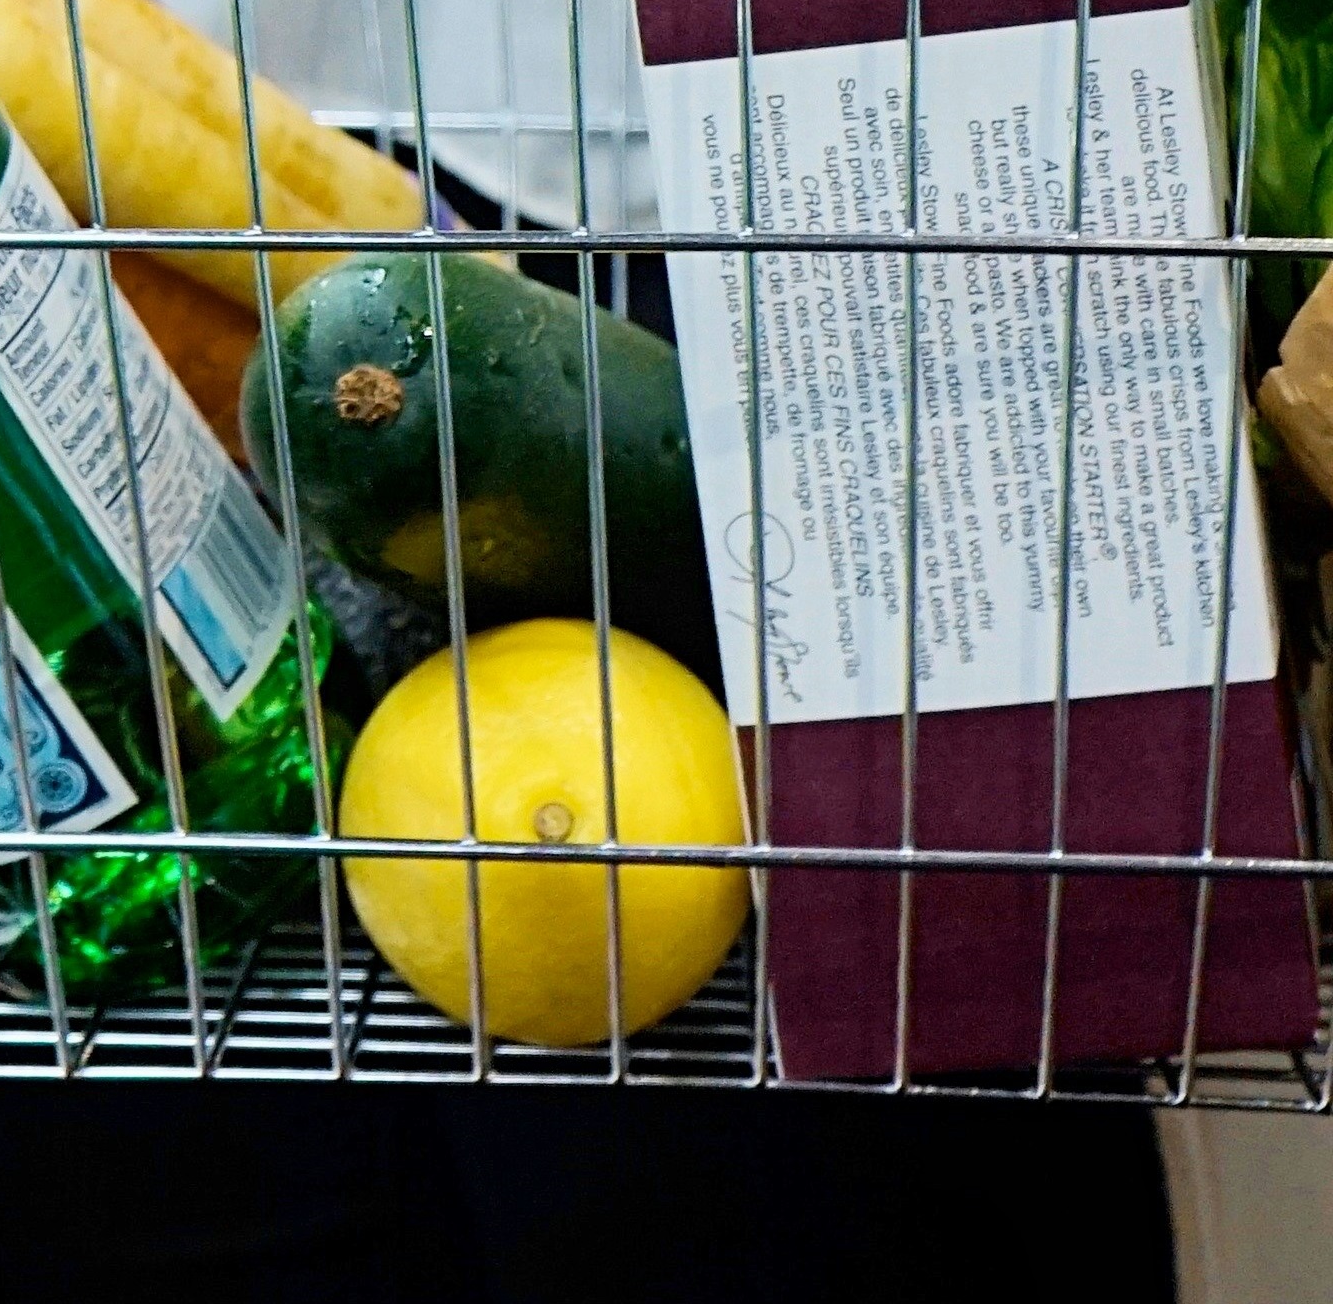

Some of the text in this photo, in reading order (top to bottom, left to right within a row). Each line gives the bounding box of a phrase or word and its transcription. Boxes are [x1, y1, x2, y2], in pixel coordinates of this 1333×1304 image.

[837, 78, 859, 121] Seul
[1130, 68, 1153, 154] delicious
[1155, 86, 1173, 106] At
[702, 114, 720, 159] vous
[766, 94, 790, 181] Délicieux
[844, 127, 859, 151] un
[864, 106, 882, 152] avec
[991, 119, 1009, 149] but
[1011, 105, 1031, 158] these
[1091, 128, 1109, 142] &
[1159, 113, 1180, 177] Lesley
[968, 120, 989, 190] cheese
[1042, 157, 1060, 172] A
[1094, 149, 1112, 181] her
[709, 165, 724, 189] ne
[843, 157, 872, 223] produit
[871, 158, 890, 203] soin,
[995, 155, 1017, 207] really
[1019, 165, 1040, 229] unique
[1121, 175, 1137, 206] are
[1142, 160, 1163, 206] food.
[779, 187, 794, 211] au
[878, 209, 893, 232] en
[978, 196, 993, 216] or
[1099, 187, 1118, 236] team
[720, 273, 742, 312] plus
[768, 271, 786, 295] de
[834, 253, 863, 322] pouvait
[1010, 269, 1030, 320] when
[1087, 270, 1112, 339] scratch
[1134, 273, 1154, 312] with
[794, 295, 810, 329] ces
[815, 285, 840, 349] POUR
[885, 87, 902, 111] de
[918, 339, 941, 420] fabuleux
[930, 426, 956, 523] craquelins
[944, 529, 964, 570] sont
[935, 298, 958, 357] Foods
[969, 301, 987, 315] &
[1113, 295, 1132, 325] the
[1157, 278, 1180, 359] fabulous
[1183, 298, 1205, 358] Foods
[730, 319, 748, 364] vous
[773, 301, 797, 397] trempette,
[868, 304, 894, 382] fabriqué
[972, 322, 988, 353] are
[994, 318, 1012, 350] We
[1041, 323, 1057, 353] are
[1118, 331, 1138, 371] only
[1139, 318, 1157, 360] care
[824, 354, 846, 398] CES
[848, 329, 873, 413] satisfaire
[977, 360, 994, 401] sure
[999, 356, 1015, 387] are
[1016, 327, 1043, 393] topped
[1097, 345, 1117, 396] using
[1146, 367, 1162, 384] in
[1192, 365, 1207, 392] we
[799, 334, 825, 432] craquelins
[944, 363, 963, 418] adore
[1123, 377, 1141, 415] way
[1169, 365, 1188, 421] crisps
[786, 402, 804, 427] de
[831, 404, 854, 453] FINS
[879, 388, 897, 433] avec
[979, 407, 999, 441] you
[1027, 397, 1048, 435] with
[1105, 402, 1121, 432] our
[1130, 420, 1145, 438] to
[1149, 389, 1171, 441] small
[1196, 397, 1213, 438] love
[861, 419, 882, 481] Lesley
[886, 438, 903, 472] des
[1004, 393, 1030, 475] addicted
[1177, 427, 1195, 470] from
[790, 432, 813, 511] fromage
[813, 437, 833, 477] sont
[952, 423, 975, 509] fabriquer
[988, 447, 1008, 478] will
[1029, 442, 1051, 482] your
[1110, 440, 1131, 490] finest
[1133, 444, 1154, 496] make
[870, 487, 886, 504] et
[993, 482, 1010, 507] be
[1015, 480, 1031, 499] to
[1156, 447, 1179, 526] batches.
[1202, 444, 1224, 514] making
[802, 516, 817, 541] ou
[839, 459, 873, 599] CRAQUELINS
[873, 510, 890, 545] son
[964, 513, 981, 532] et
[1018, 504, 1037, 537] this
[1141, 503, 1154, 514] a
[1183, 477, 1208, 553] Lesley's
[967, 538, 985, 583] vous
[1139, 520, 1164, 569] great
[924, 555, 941, 579] de
[1019, 543, 1045, 613] yummy
[974, 588, 994, 631] offrir
[1075, 578, 1093, 618] own
[1146, 574, 1174, 647] product
[1194, 559, 1216, 628] kitchen
